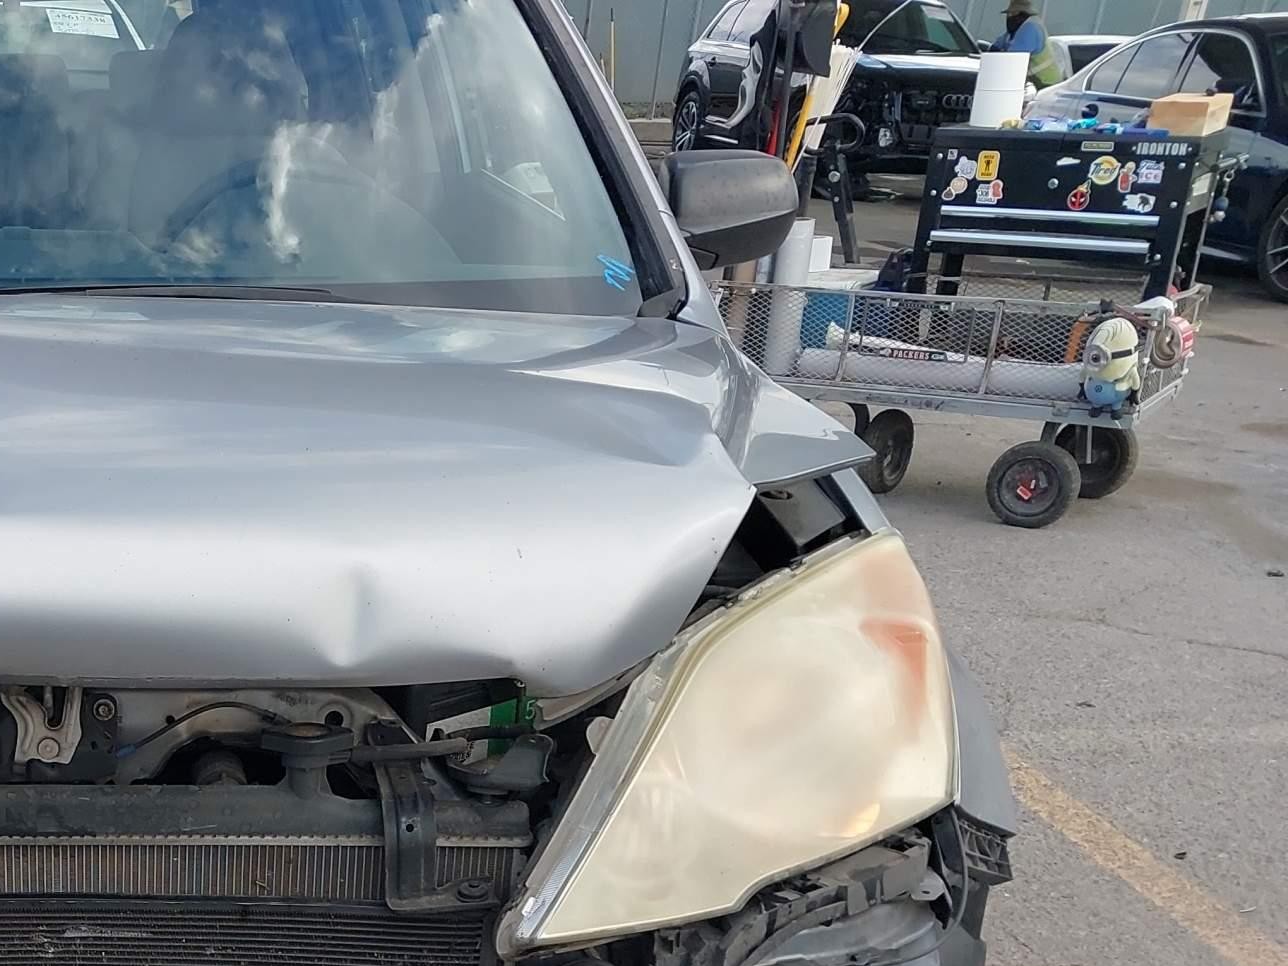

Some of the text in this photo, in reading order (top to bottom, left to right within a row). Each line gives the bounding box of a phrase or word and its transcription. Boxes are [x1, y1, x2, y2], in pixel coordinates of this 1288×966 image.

[1136, 142, 1188, 156] IRONTON
[1092, 162, 1116, 176] Tired
[893, 349, 930, 360] PACKERS
